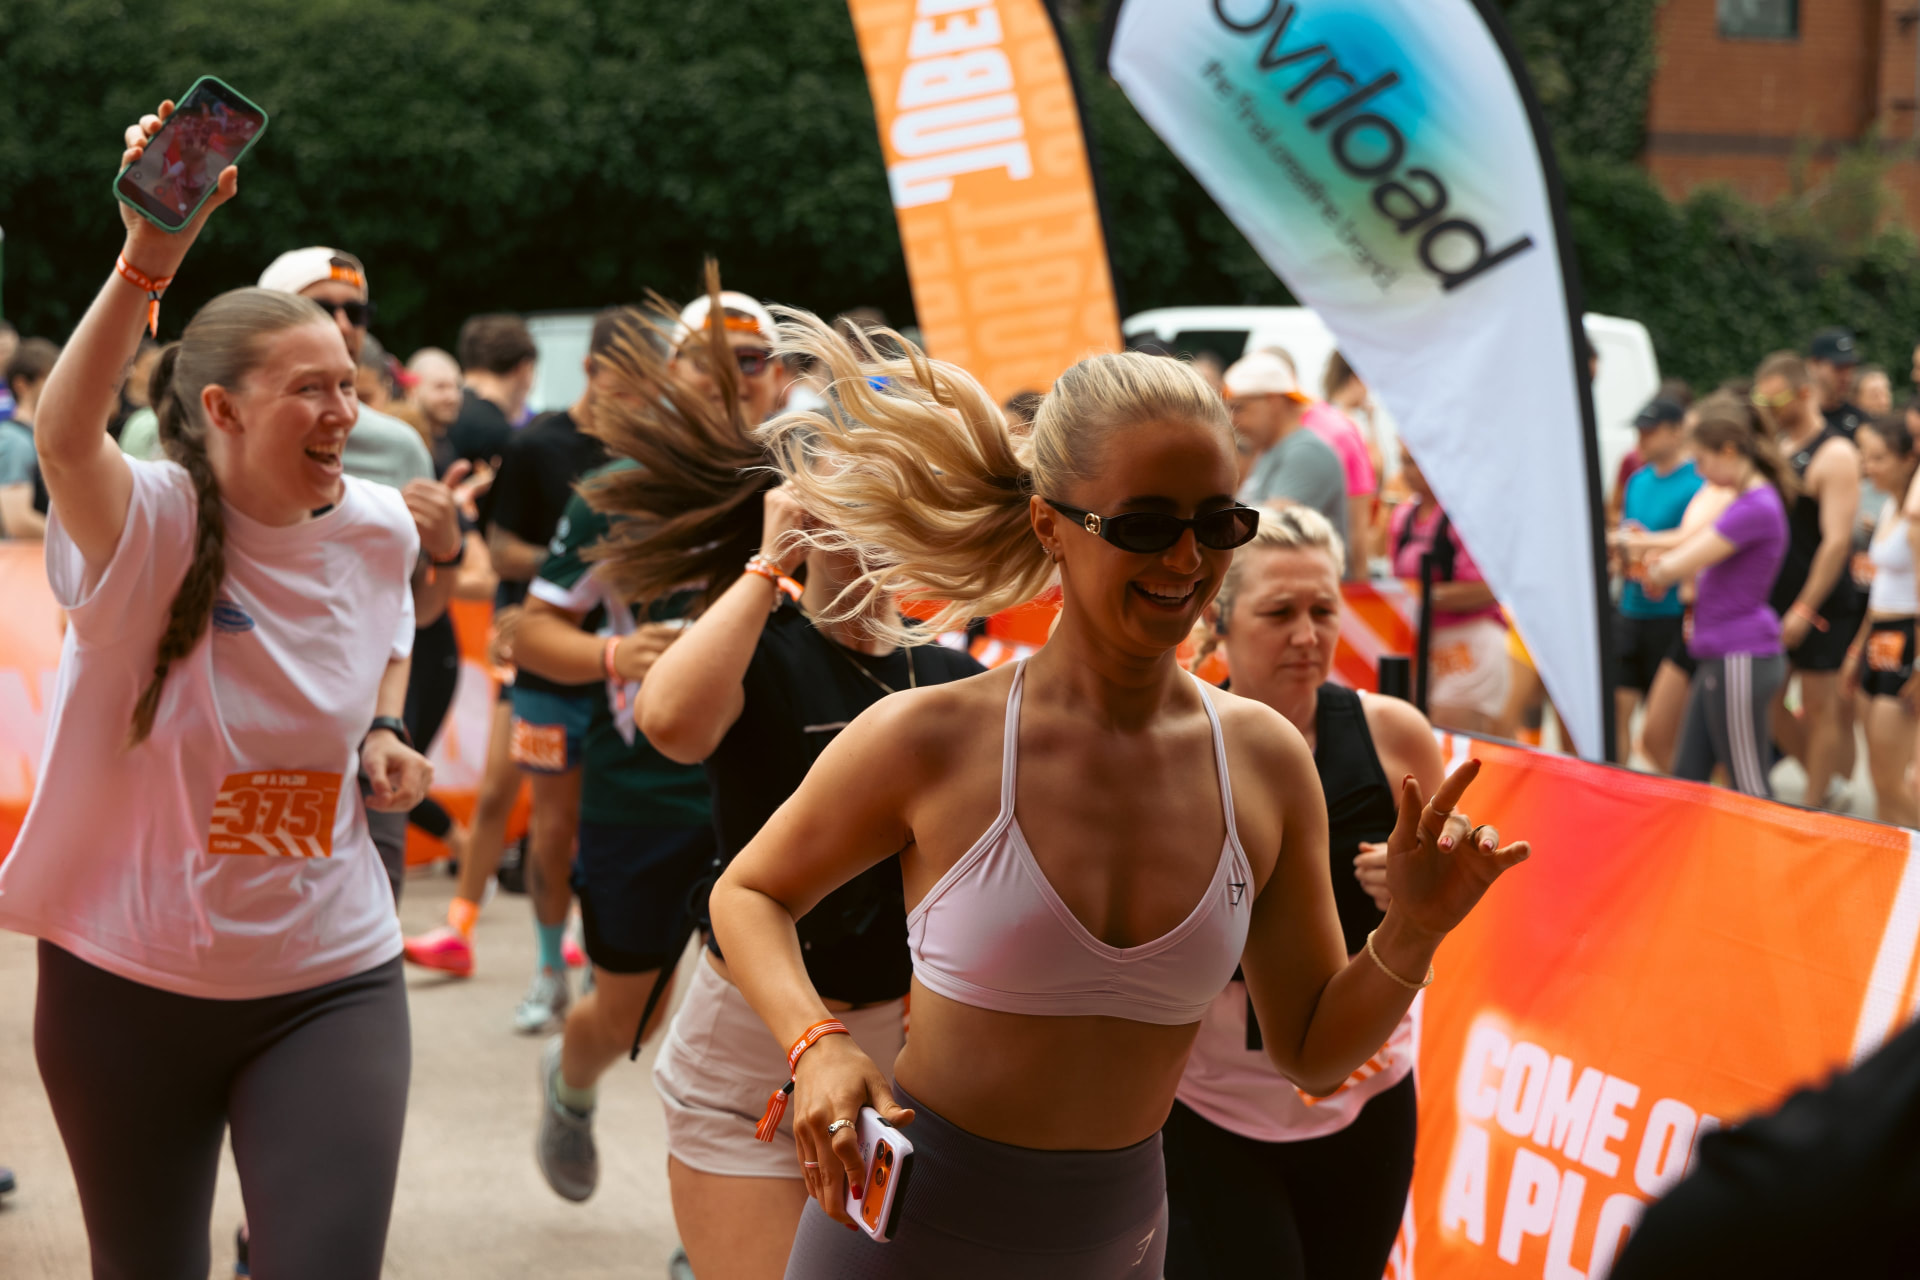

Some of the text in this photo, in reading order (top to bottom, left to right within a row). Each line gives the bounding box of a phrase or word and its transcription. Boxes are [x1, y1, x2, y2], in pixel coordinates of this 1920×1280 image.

[225, 786, 324, 839] 375
[790, 1039, 808, 1062] MCR
[1459, 1014, 1722, 1200] COME O
[1443, 1121, 1490, 1247] A
